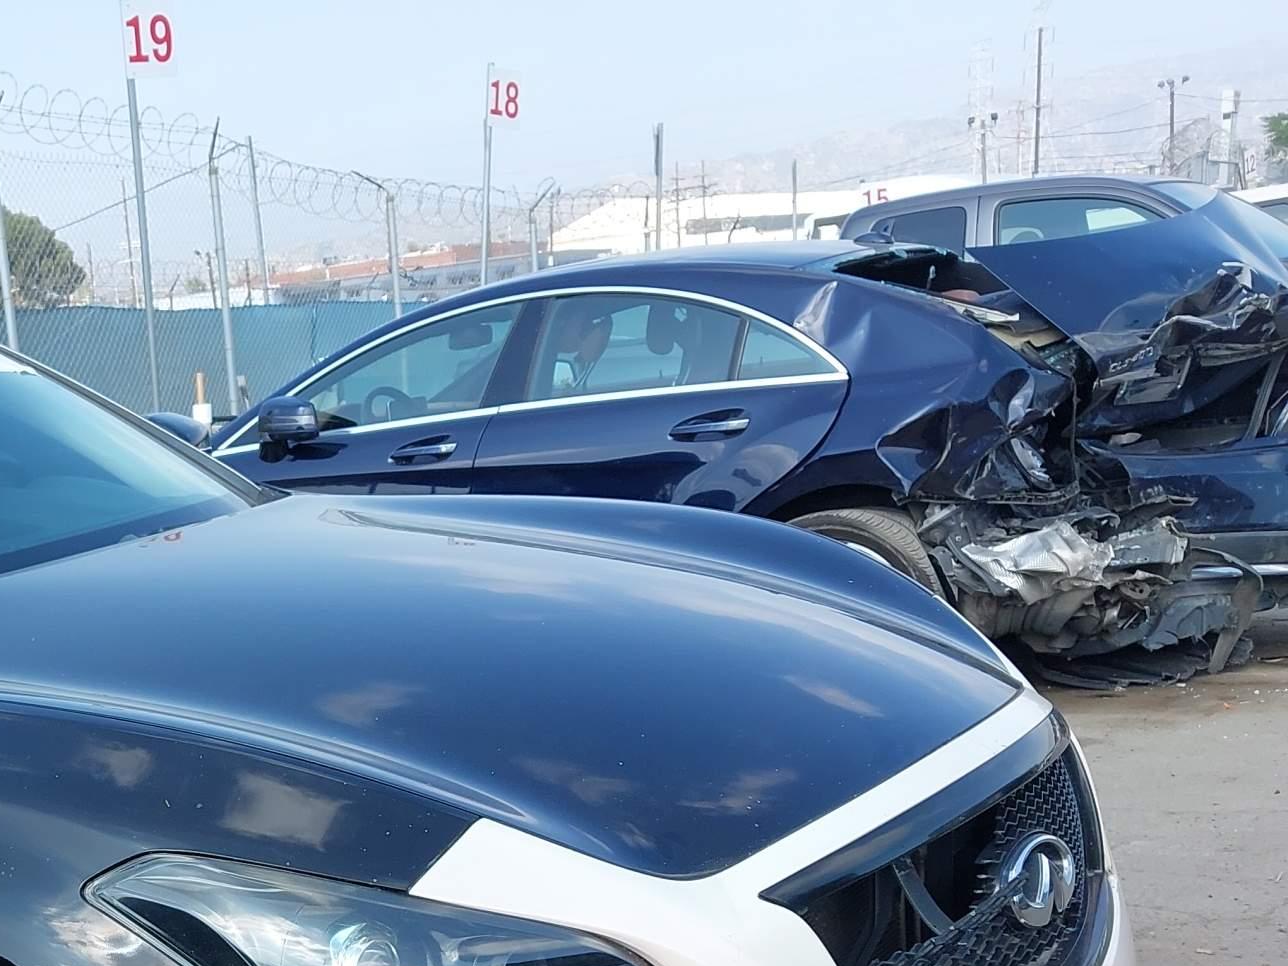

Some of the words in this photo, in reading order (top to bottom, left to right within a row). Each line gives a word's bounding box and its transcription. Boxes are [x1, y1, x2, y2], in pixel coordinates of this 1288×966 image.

[126, 14, 172, 63] 19
[490, 80, 519, 119] 18
[862, 188, 889, 206] 15
